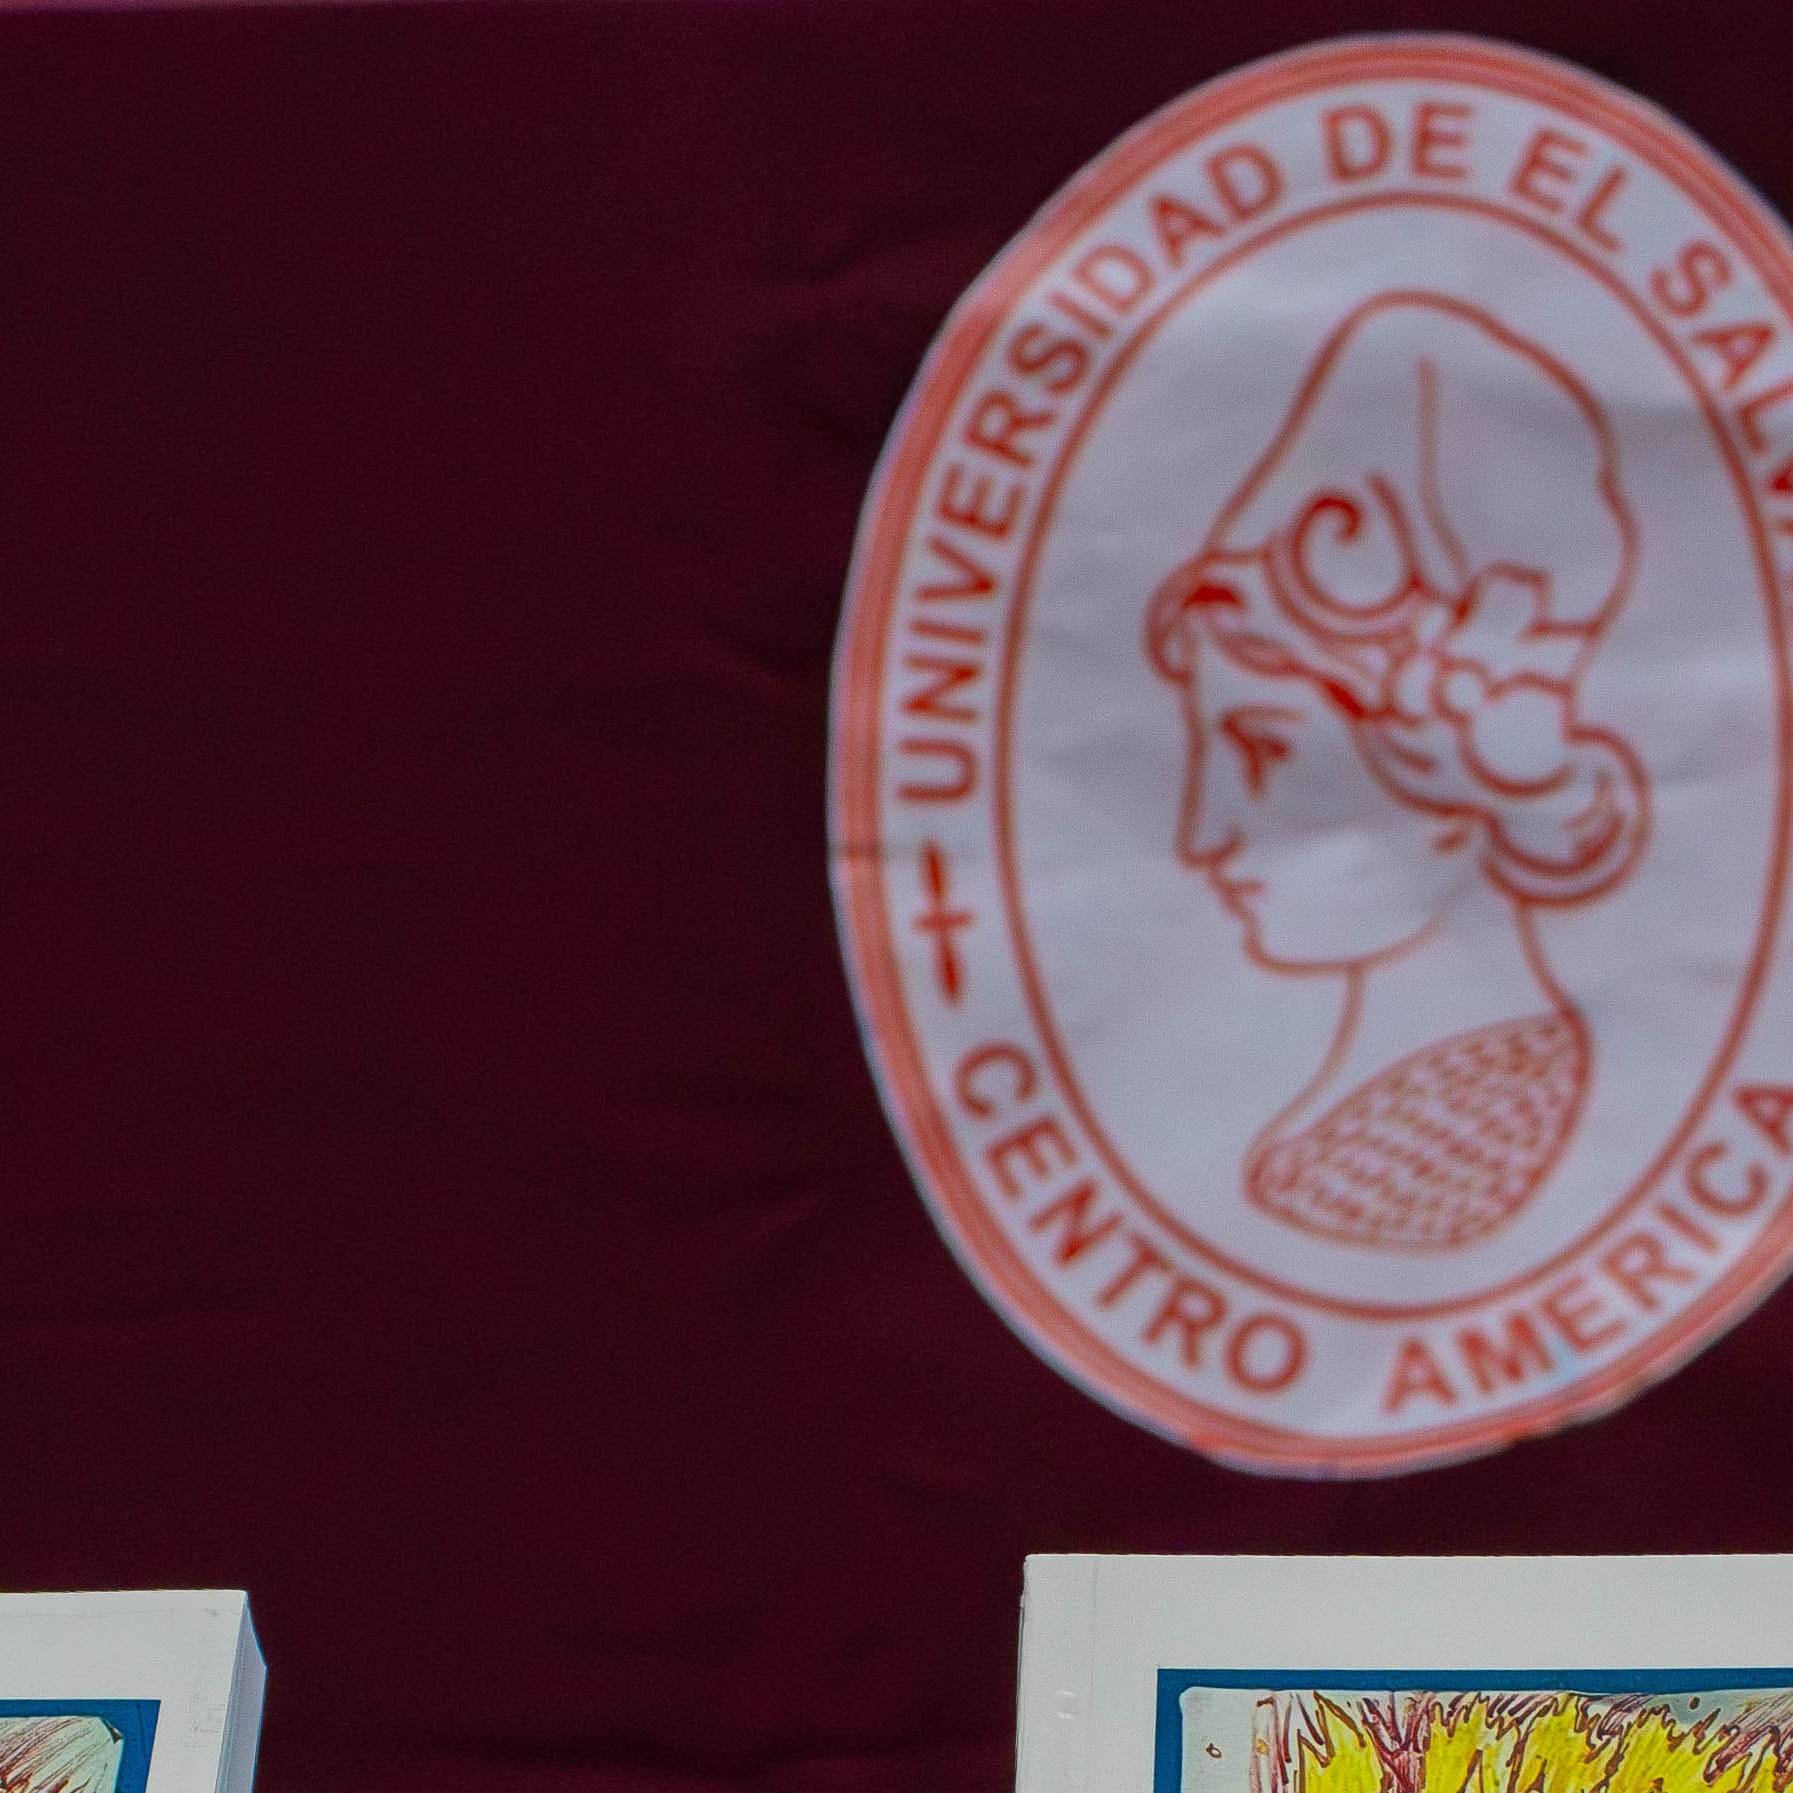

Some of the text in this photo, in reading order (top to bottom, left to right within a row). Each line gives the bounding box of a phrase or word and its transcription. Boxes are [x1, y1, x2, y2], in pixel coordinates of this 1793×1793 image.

[895, 140, 1287, 805] UNIVERSIDAD
[1320, 100, 1475, 188] DE
[1505, 122, 1634, 256] EL
[949, 1038, 1309, 1396] CENTRO
